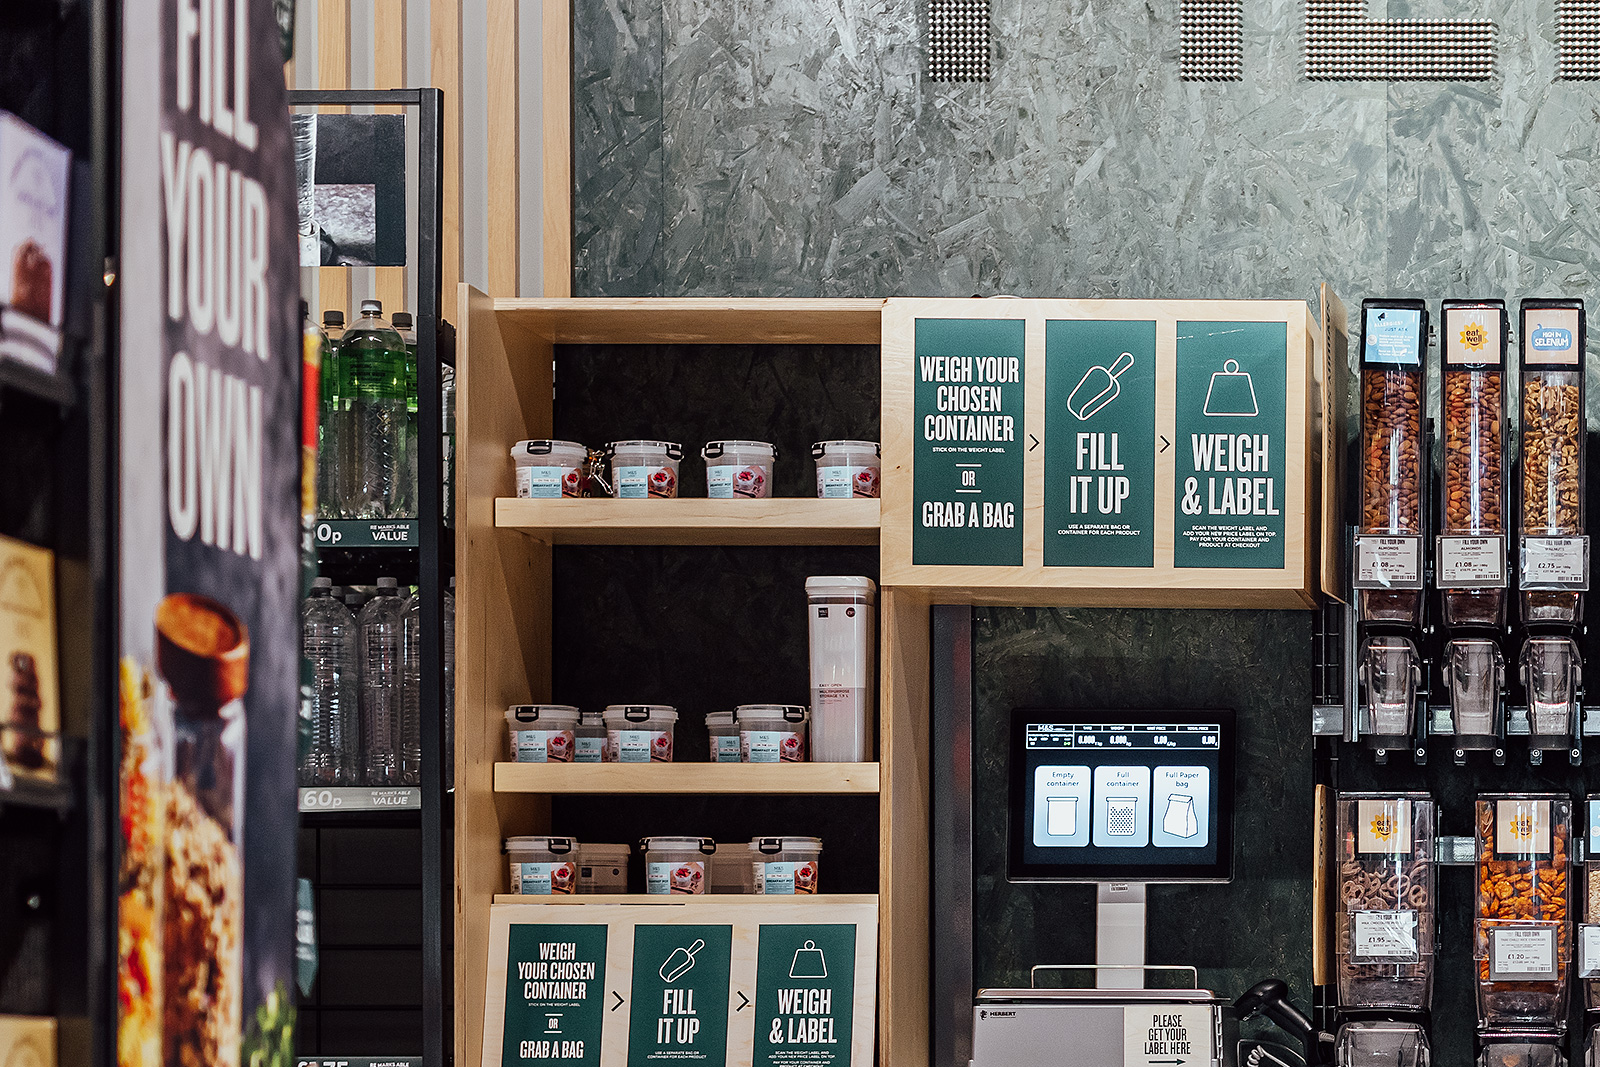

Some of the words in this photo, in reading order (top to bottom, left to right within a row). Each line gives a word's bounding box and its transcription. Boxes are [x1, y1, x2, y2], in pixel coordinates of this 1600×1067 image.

[176, 0, 258, 151] FILL
[161, 131, 269, 361] YOUR
[1534, 337, 1569, 347] SELENIUM
[919, 356, 973, 382] WEIGH
[975, 356, 1020, 383] YOUR
[937, 385, 1002, 412] CHOSEN
[924, 415, 1014, 441] CONTAINER
[168, 351, 263, 562] OWN
[1076, 432, 1124, 471] FILL
[1191, 433, 1269, 472] WEIGH
[961, 470, 976, 487] OR
[1070, 476, 1093, 514] IT
[1098, 476, 1130, 514] UP
[1181, 476, 1203, 515] &
[1208, 477, 1280, 516] LABEL
[922, 501, 965, 528] GRAB
[968, 502, 980, 528] A
[982, 502, 1015, 528] BAG
[372, 531, 408, 541] VALUE
[1052, 771, 1074, 779] Empty
[1179, 771, 1199, 779] Paper
[303, 790, 342, 808] 60p
[372, 796, 408, 805] VALUE
[539, 942, 576, 960] WEIGH
[517, 962, 548, 980] YOUR
[549, 962, 595, 980] CHOSEN
[524, 981, 587, 1000] CONTAINER
[777, 988, 832, 1015] WEIGH
[663, 989, 697, 1015] FILL
[548, 1018, 558, 1029] OR
[657, 1018, 674, 1043] IT
[677, 1018, 700, 1044] UP
[769, 1017, 784, 1044] &
[787, 1017, 838, 1044] LABEL
[1152, 1015, 1182, 1027] PLEASE
[1148, 1028, 1164, 1041] GET
[1164, 1028, 1187, 1041] YOUR
[519, 1040, 550, 1059] GRAB
[551, 1040, 560, 1059] A
[561, 1040, 584, 1059] BAG
[1144, 1042, 1168, 1054] LABEL
[1170, 1042, 1191, 1054] HERE
